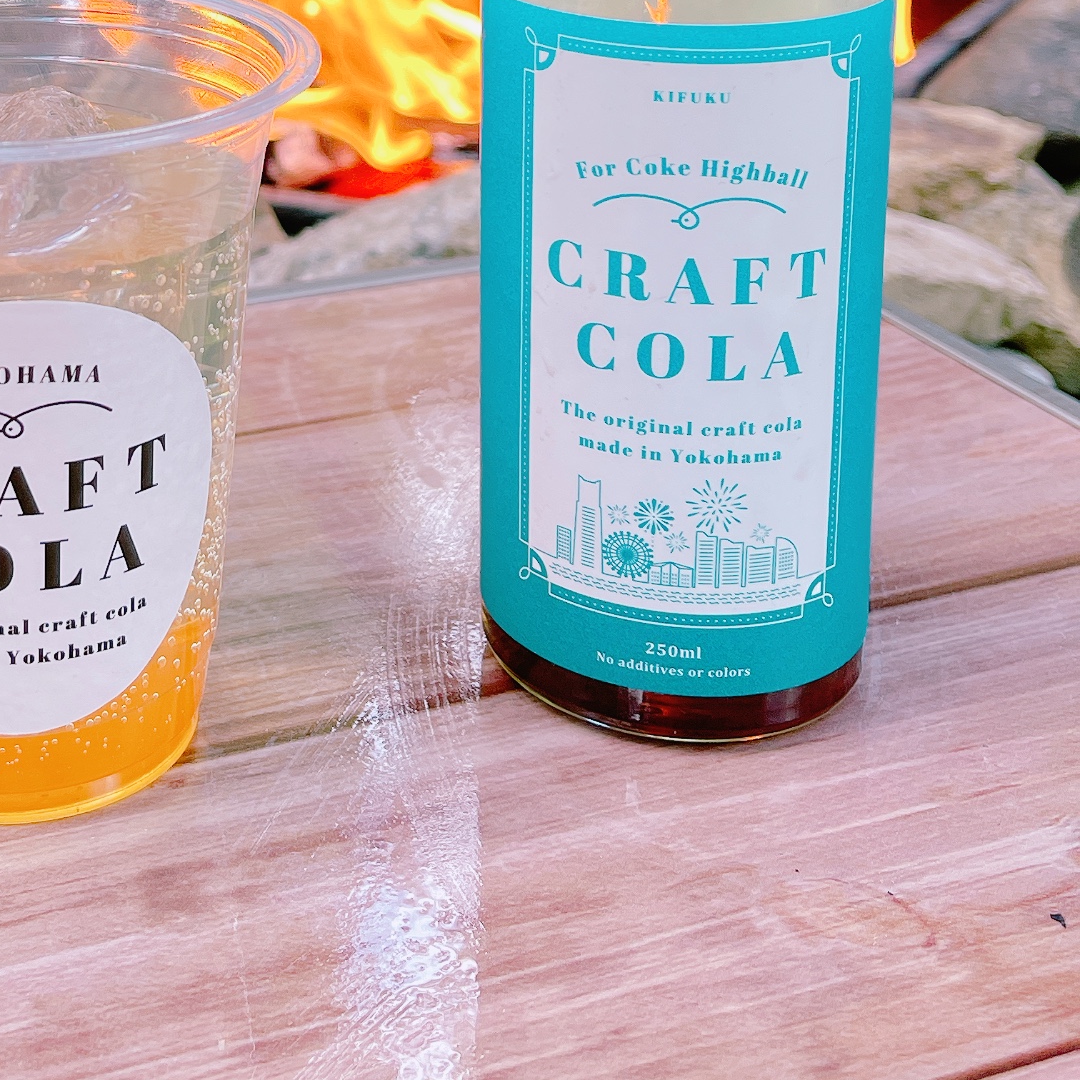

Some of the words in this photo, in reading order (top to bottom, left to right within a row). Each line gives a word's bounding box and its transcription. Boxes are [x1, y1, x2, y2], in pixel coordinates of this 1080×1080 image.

[653, 90, 732, 104] KIFUKU
[575, 160, 617, 179] For
[626, 156, 690, 177] Coke
[701, 159, 809, 190] Highball
[547, 239, 826, 305] CRAFT
[576, 322, 803, 382] COLA
[561, 399, 597, 422] The
[604, 413, 692, 436] original
[701, 420, 756, 437] craft
[764, 416, 802, 434] cola
[579, 435, 633, 458] made
[641, 446, 662, 461] in
[671, 448, 782, 465] Yokohama
[39, 610, 99, 633] craft
[106, 595, 147, 621] cola
[7, 635, 127, 666] Yokohama
[596, 650, 614, 665] No
[618, 658, 684, 677] additives
[689, 667, 704, 677] or
[708, 665, 751, 678] colors
[645, 641, 702, 660] 250ml
